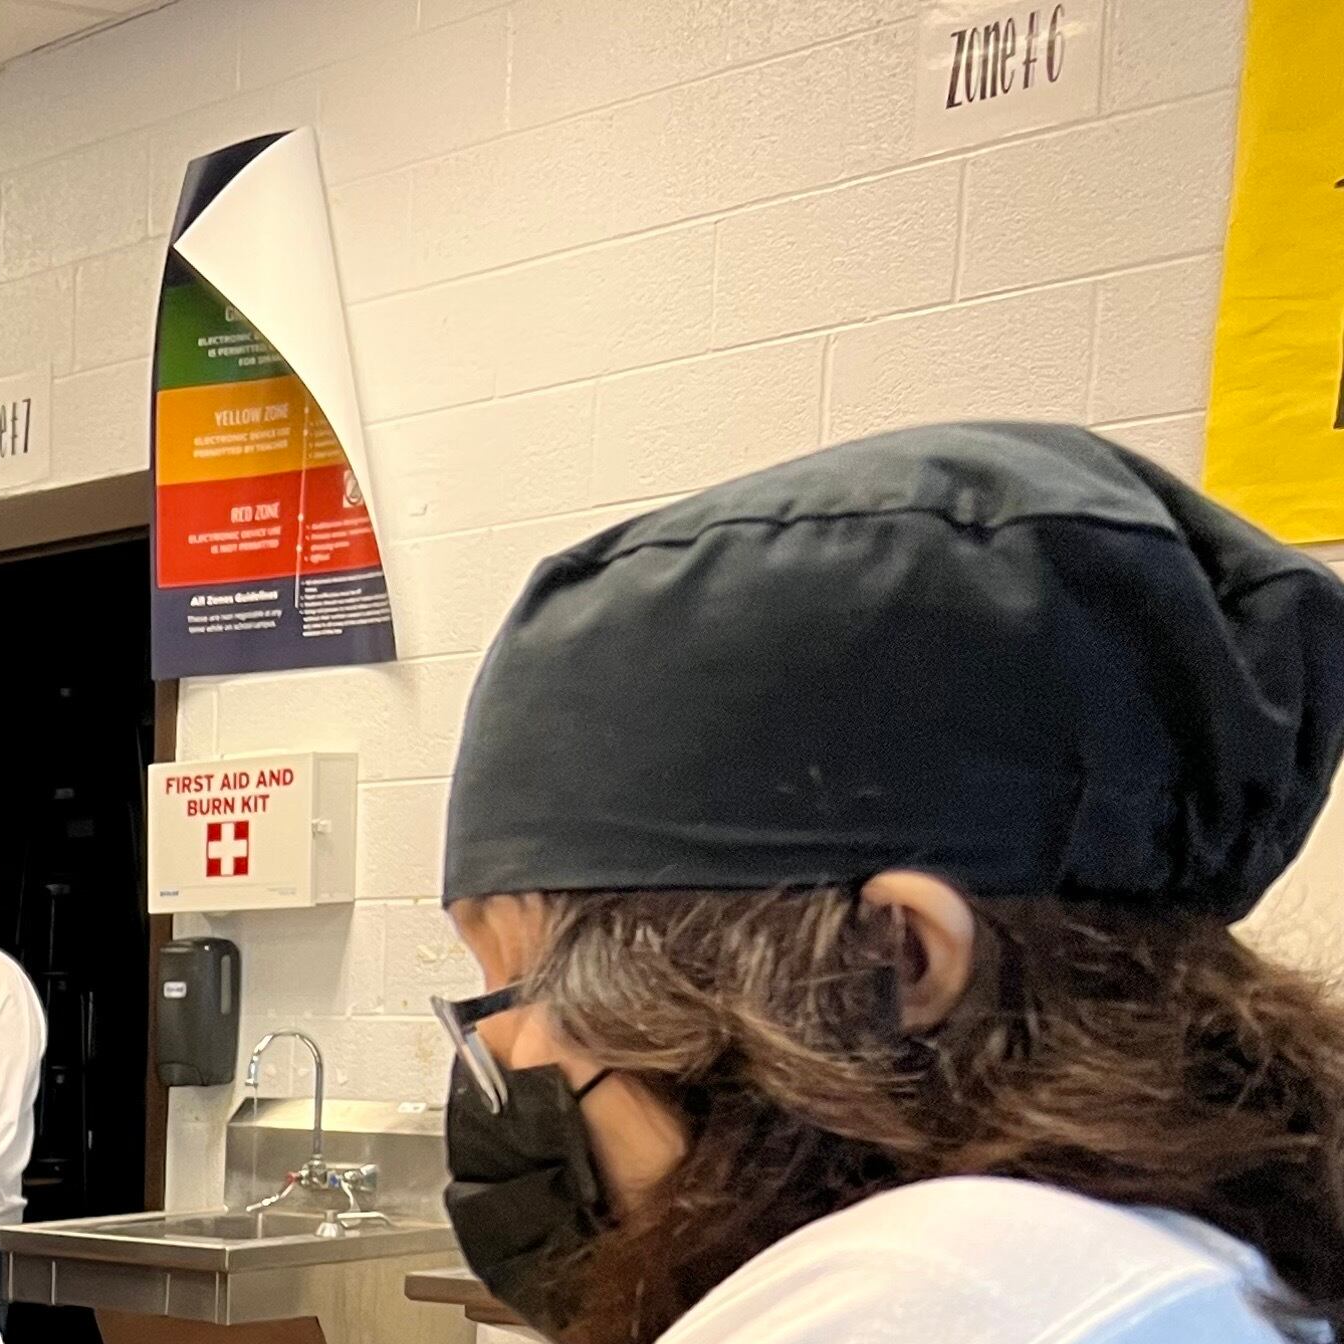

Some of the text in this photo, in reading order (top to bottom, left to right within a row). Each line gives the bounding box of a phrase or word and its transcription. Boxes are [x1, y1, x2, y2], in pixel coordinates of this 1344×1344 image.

[215, 403, 289, 426] YELLOW ZONE
[231, 506, 253, 523] RED
[165, 768, 294, 794] FIRST AID AND
[187, 794, 270, 817] BURN KIT
